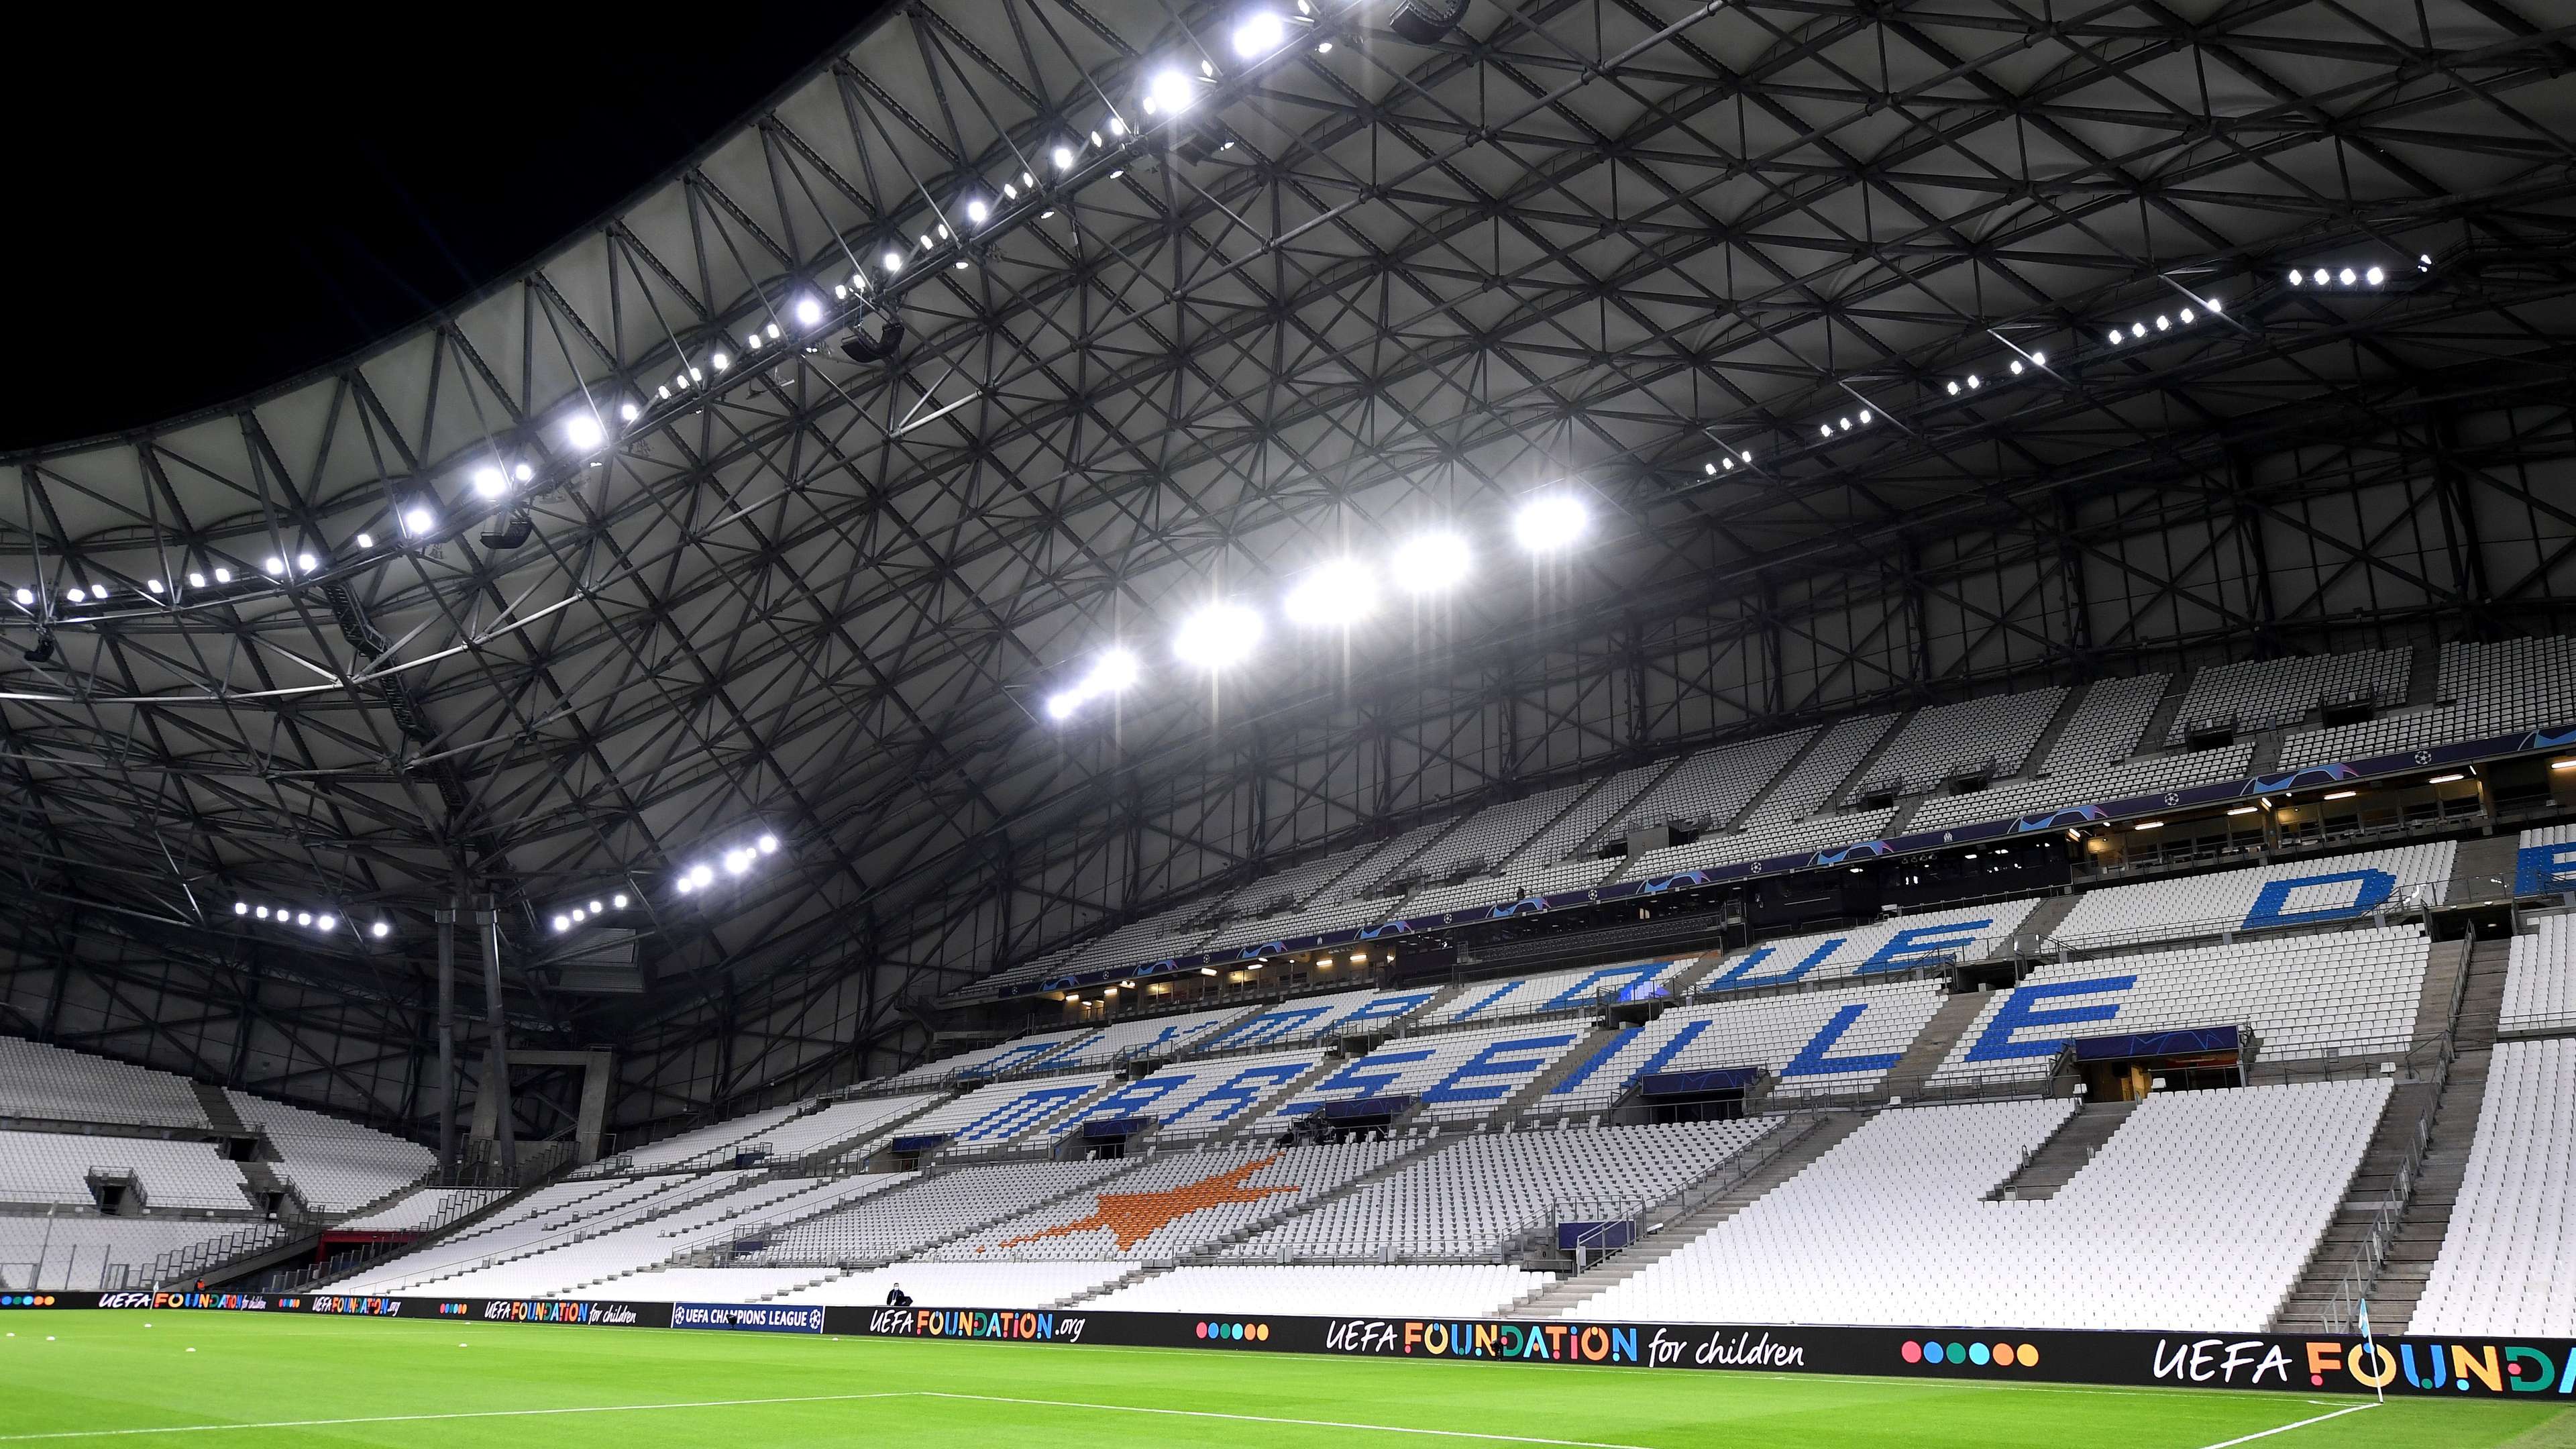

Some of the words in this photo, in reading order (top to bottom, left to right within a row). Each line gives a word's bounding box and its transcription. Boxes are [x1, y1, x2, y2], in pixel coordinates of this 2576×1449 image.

[99, 1293, 152, 1308] UEFA
[154, 1293, 242, 1309] FOUNDATION
[313, 1296, 332, 1312] UEFA
[484, 1301, 511, 1320] UEFA
[511, 1301, 588, 1322] FOUNDATION
[588, 1303, 604, 1325] for
[602, 1304, 637, 1324] children
[686, 1308, 709, 1324] UEFA
[768, 1311, 808, 1327] LEAGUE
[870, 1309, 914, 1334] UEFA
[1326, 1320, 1398, 1352] UEFA
[1404, 1322, 1638, 1362] FOUNDATION
[1648, 1327, 1687, 1368] for
[1695, 1330, 1805, 1367] children
[2153, 1338, 2293, 1385] UEFA
